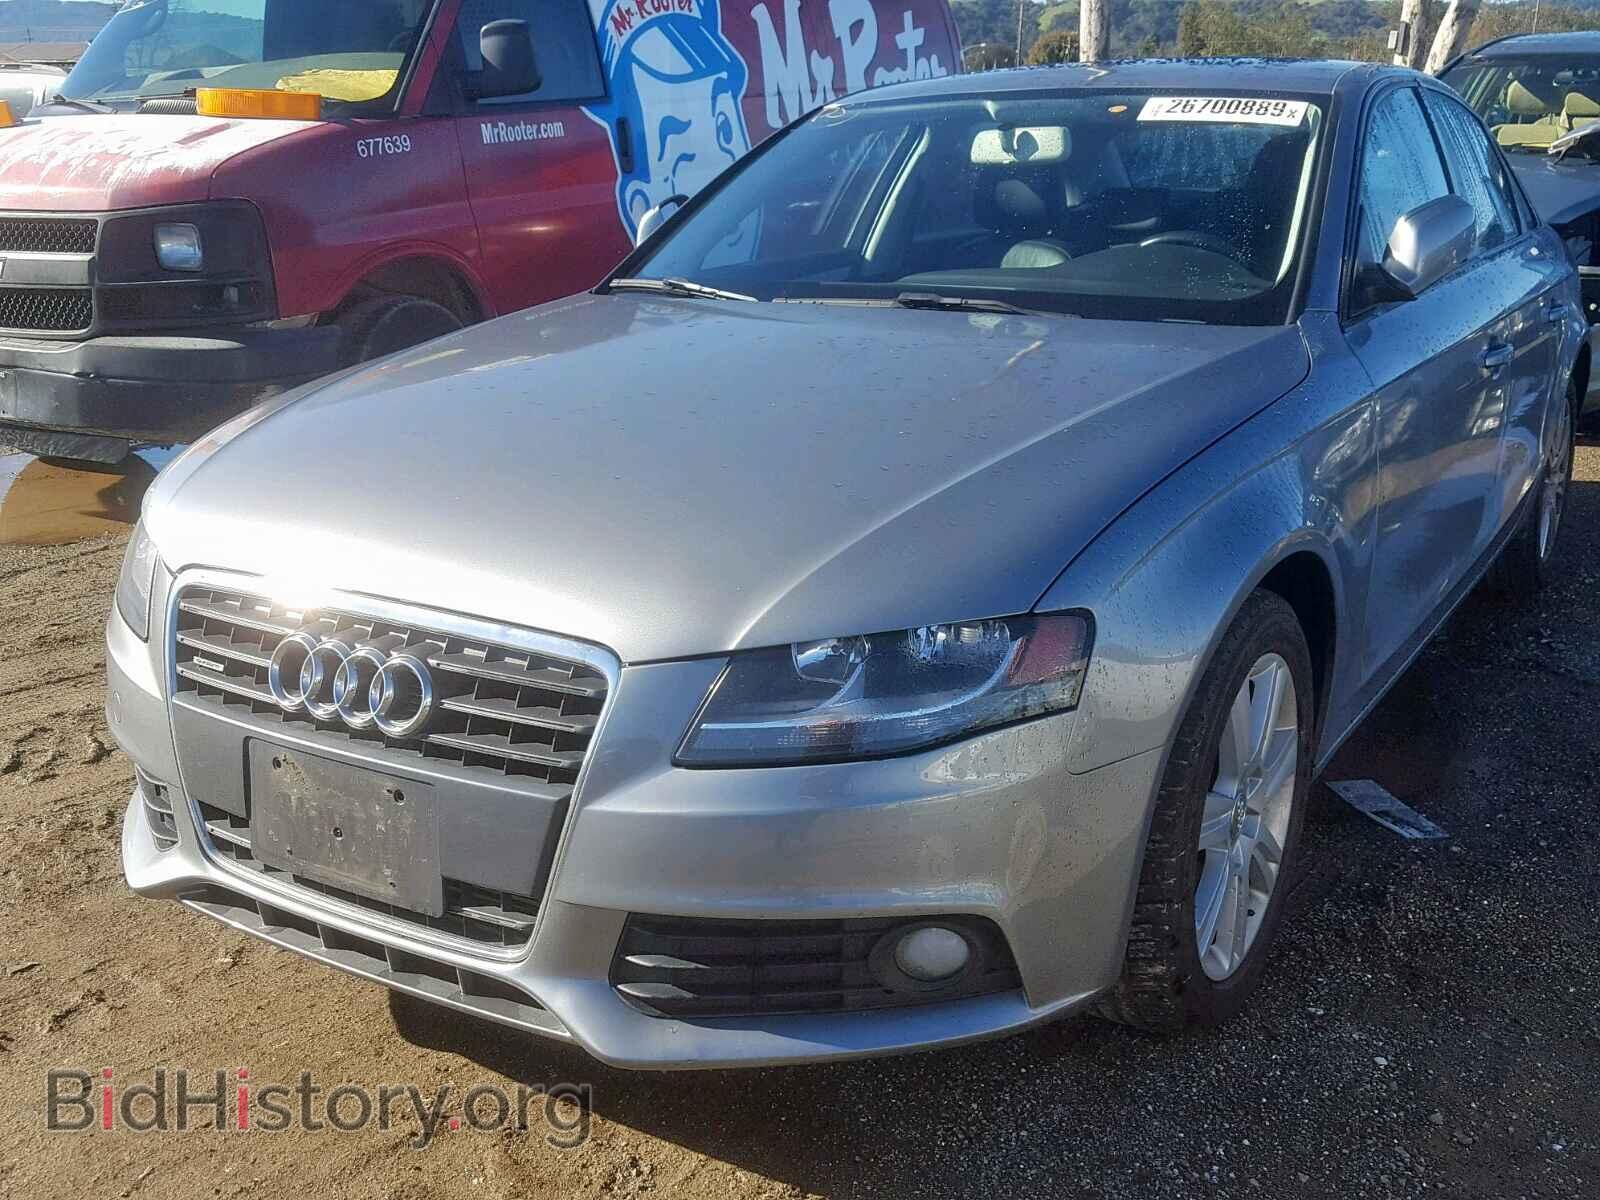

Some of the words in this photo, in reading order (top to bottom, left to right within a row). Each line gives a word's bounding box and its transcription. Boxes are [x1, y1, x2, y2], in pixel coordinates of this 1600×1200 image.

[1165, 98, 1287, 117] 26700889
[480, 120, 565, 145] MrRooter.com
[356, 134, 411, 158] 677639
